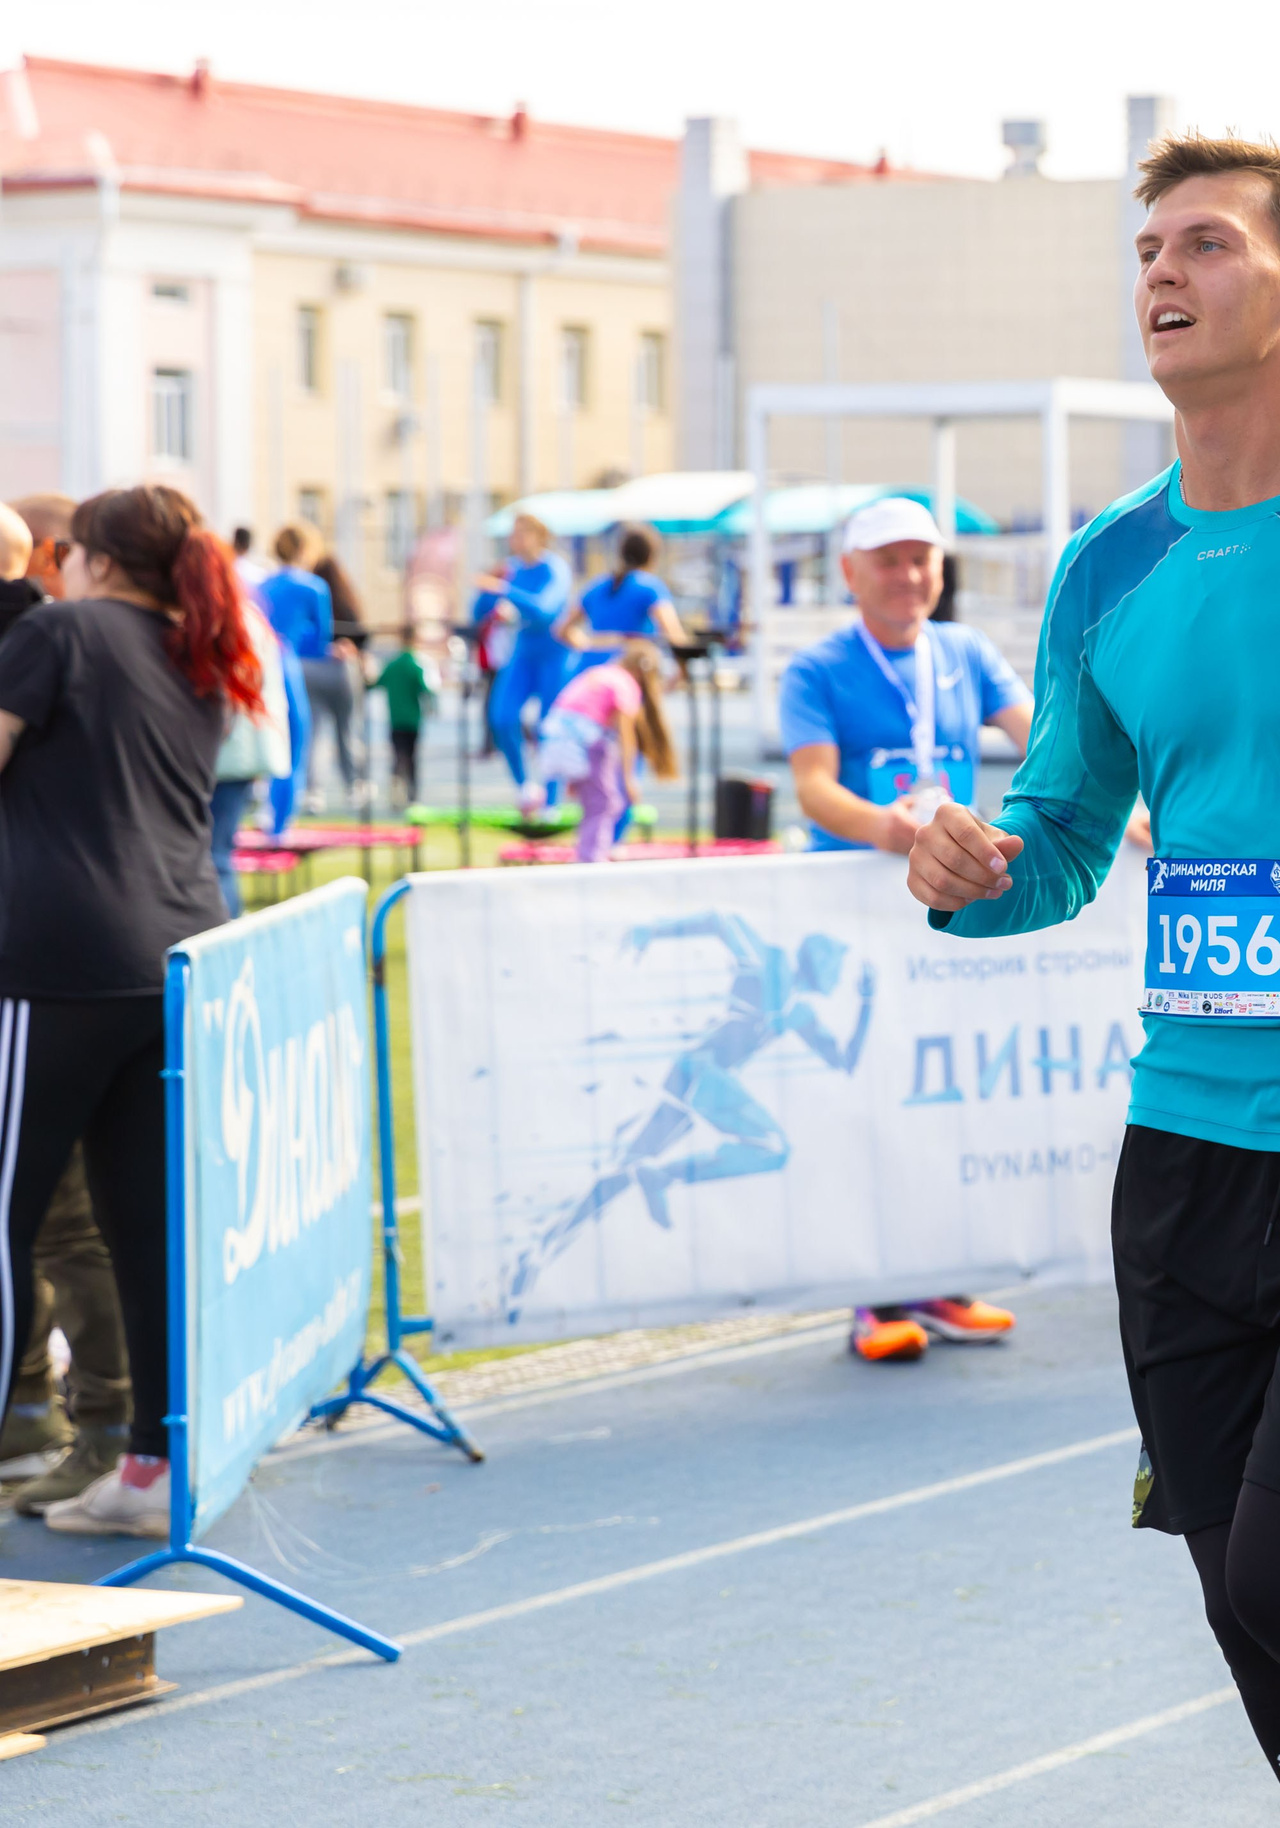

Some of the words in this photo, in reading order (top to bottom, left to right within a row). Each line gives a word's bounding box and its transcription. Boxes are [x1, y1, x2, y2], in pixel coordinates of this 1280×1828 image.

[1197, 544, 1239, 561] CRAFT
[1170, 863, 1257, 877] ДИНАМОВСКАЯ
[1190, 879, 1226, 892] МИЛЯ
[906, 953, 1025, 981] История
[1035, 948, 1132, 975] страны
[902, 1020, 1132, 1106] ДИНА
